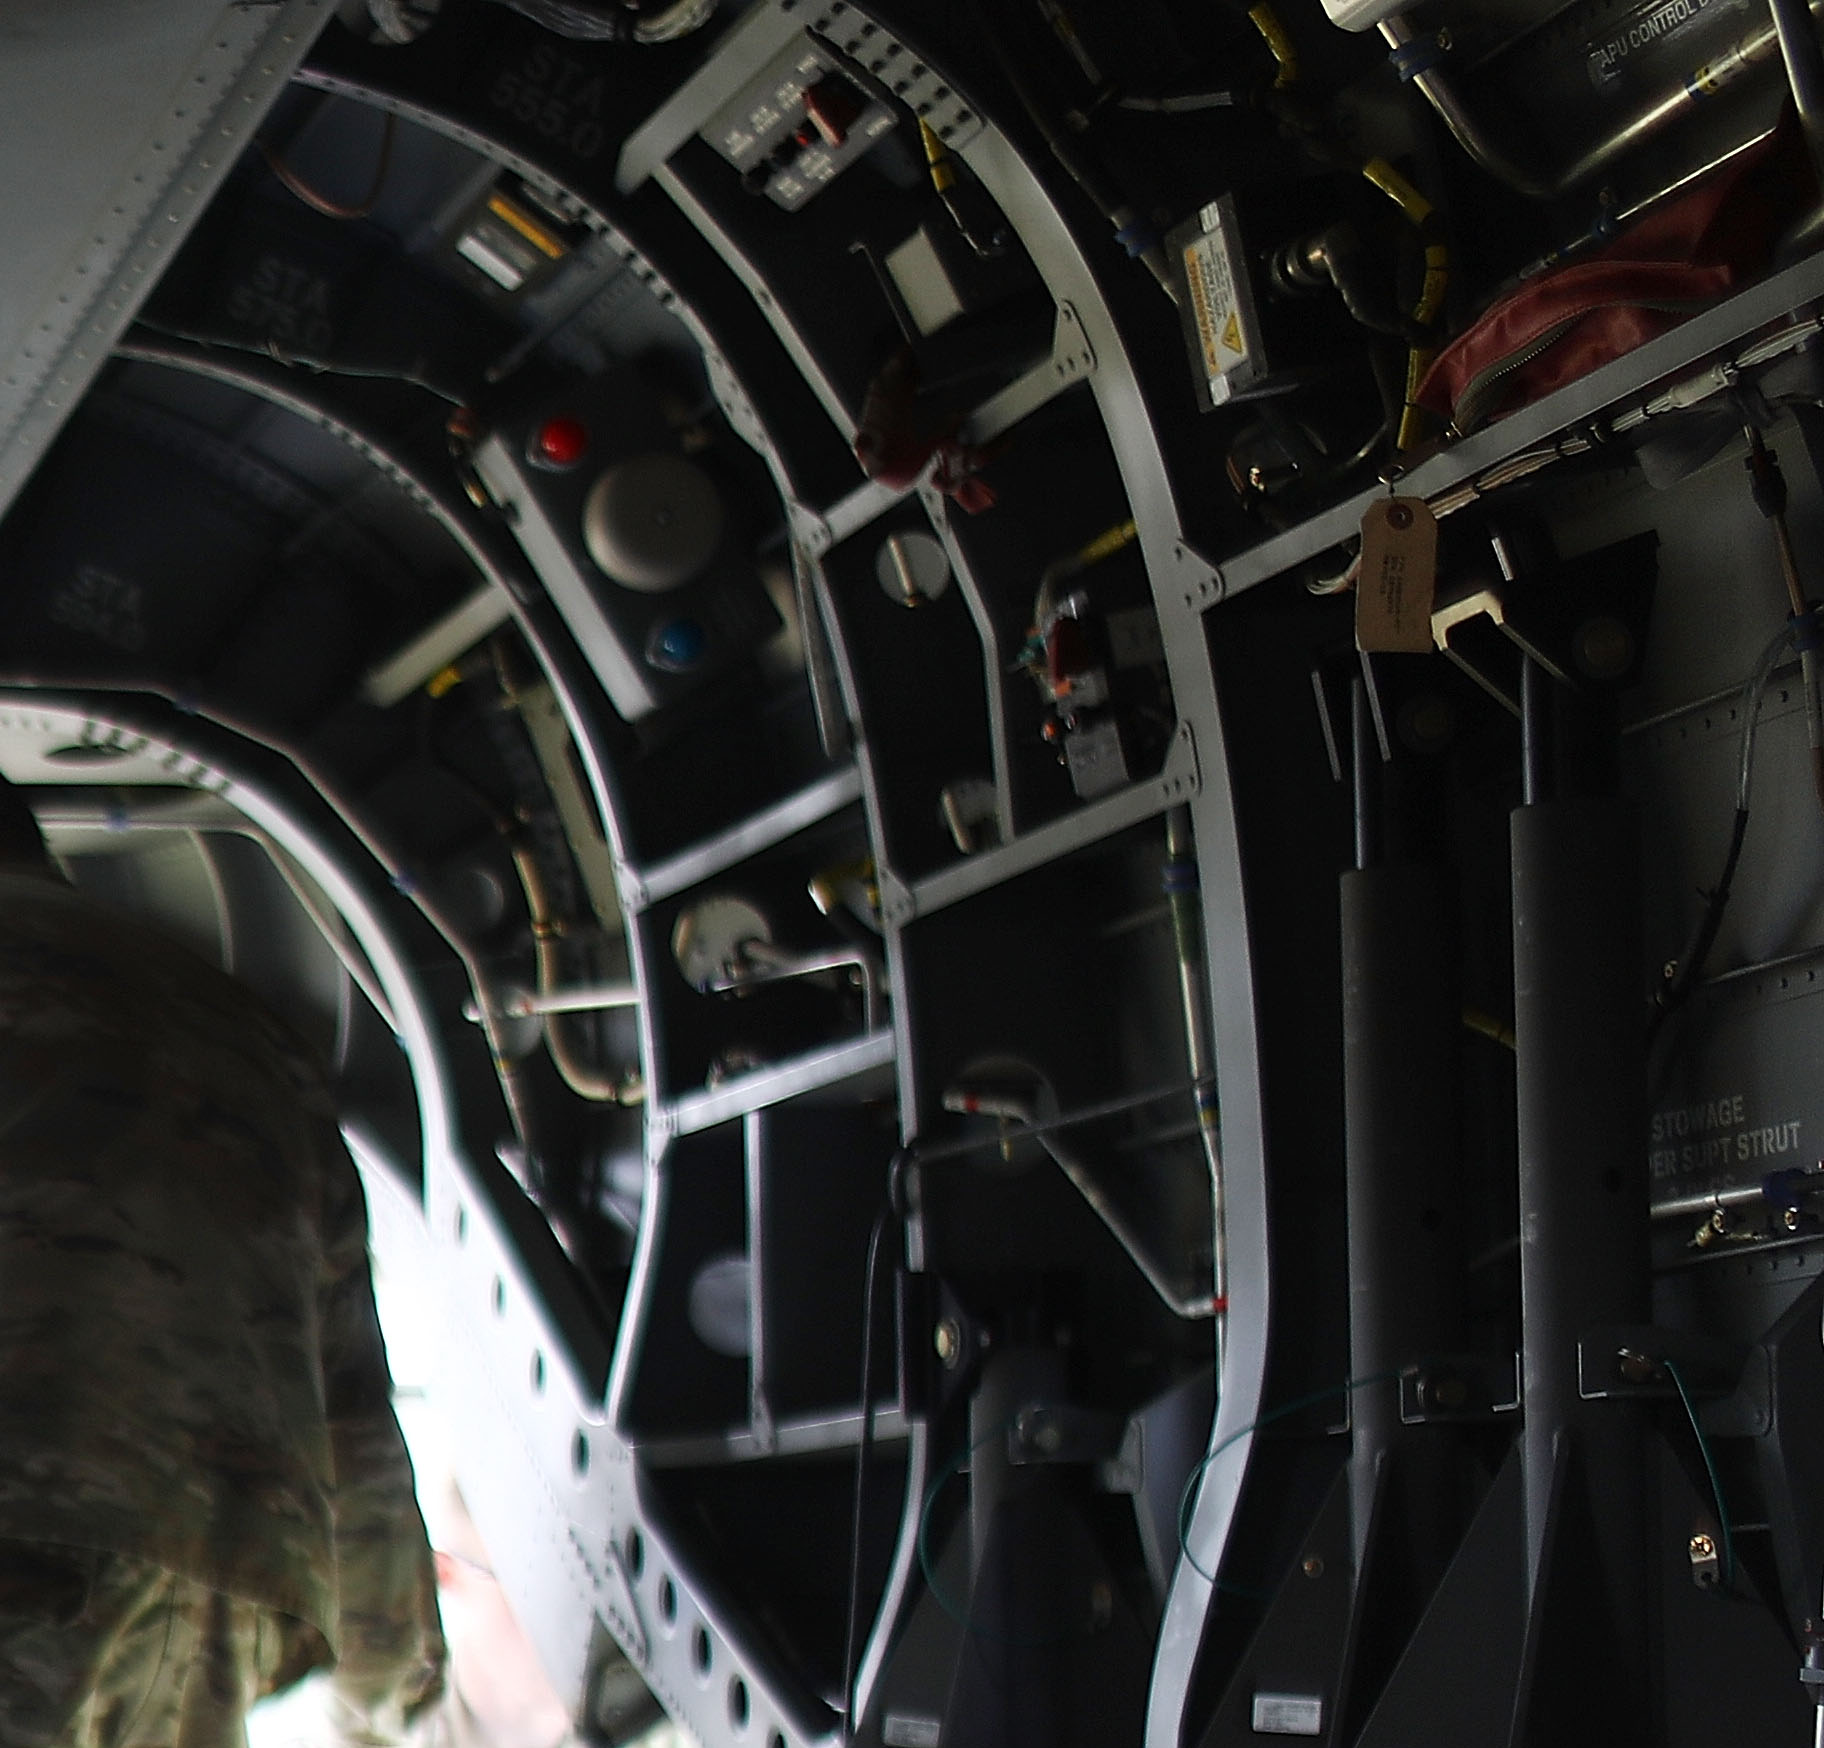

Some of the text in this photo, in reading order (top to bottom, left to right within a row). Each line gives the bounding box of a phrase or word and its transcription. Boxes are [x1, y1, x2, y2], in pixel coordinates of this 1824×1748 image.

[1601, 0, 1697, 67] APU CONTROL
[523, 43, 604, 117] STA
[489, 71, 604, 159] 555.0
[252, 256, 329, 316] STA
[1652, 1095, 1745, 1142] STOWAGE
[1737, 1121, 1801, 1161] STRUT
